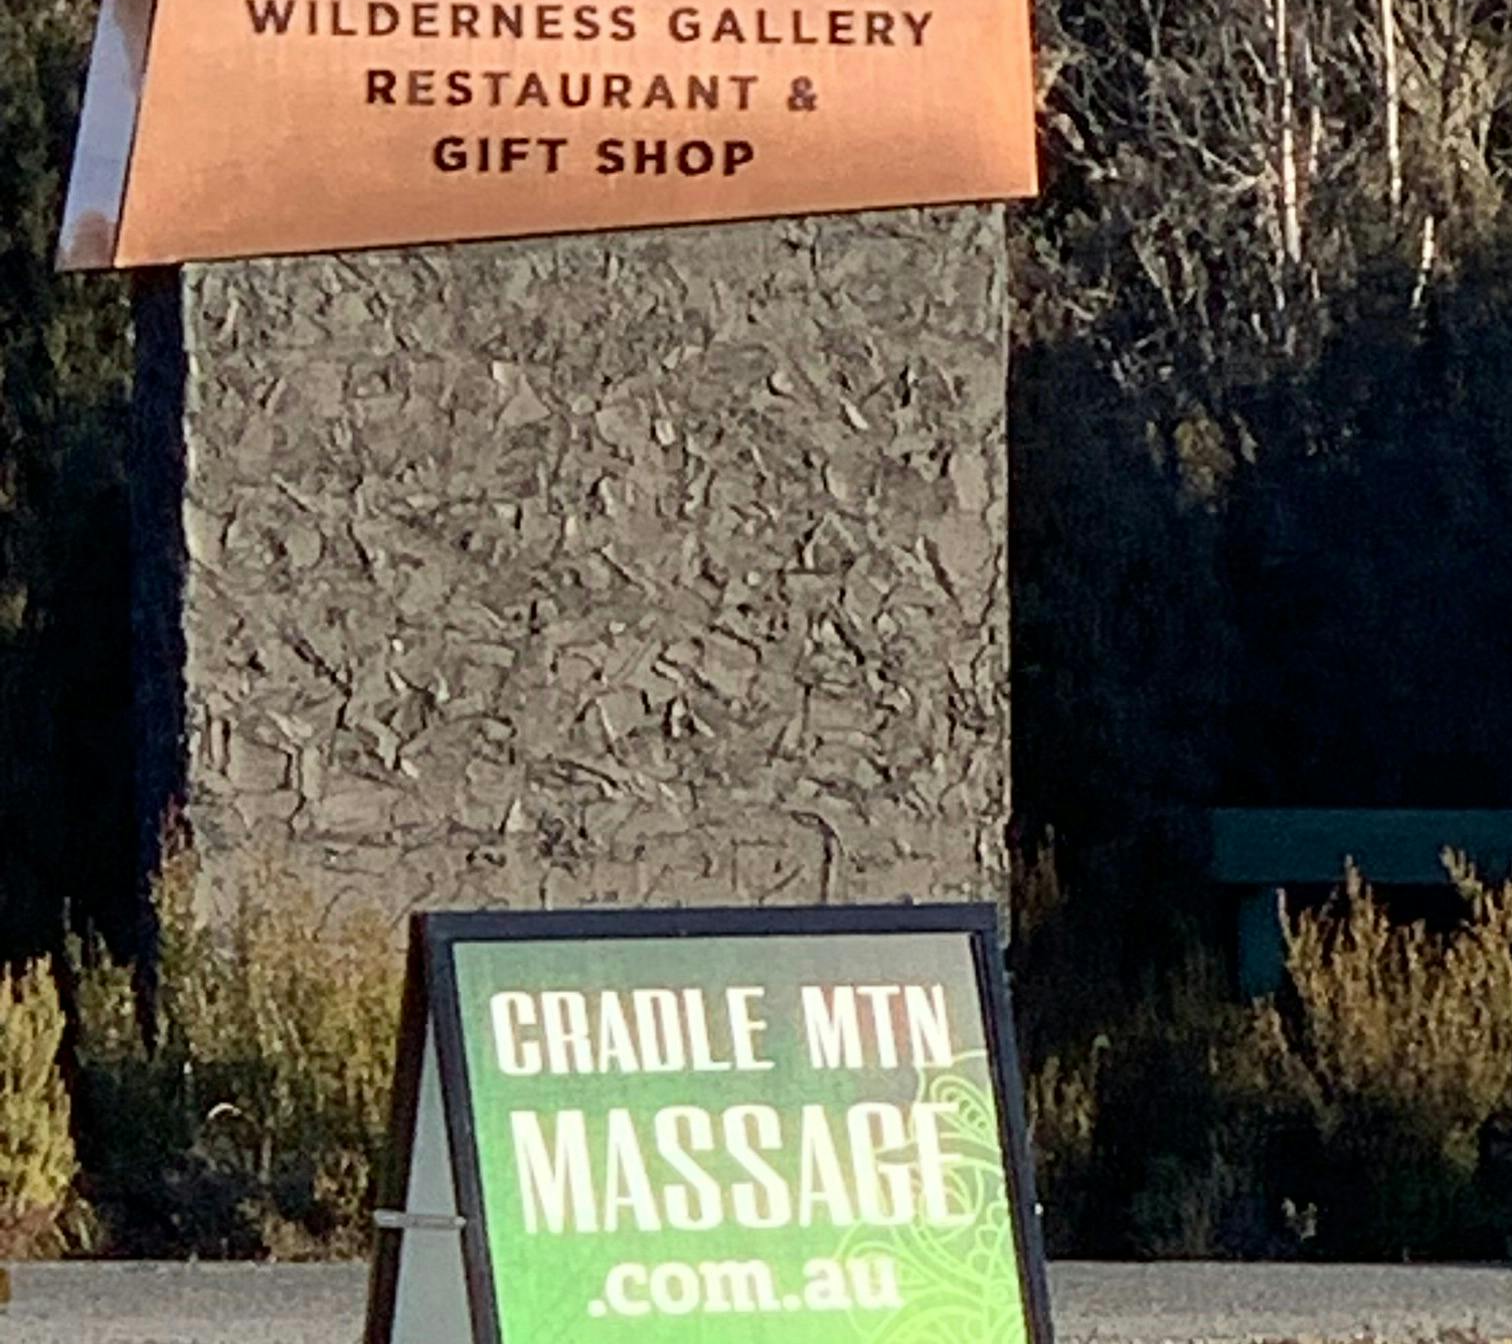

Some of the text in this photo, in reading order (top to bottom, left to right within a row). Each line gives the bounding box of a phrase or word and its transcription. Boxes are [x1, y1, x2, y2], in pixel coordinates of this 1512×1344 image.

[667, 6, 934, 47] GALLERY
[364, 68, 819, 113] RESTAURANT &
[431, 135, 757, 177] GIFT SHOP
[489, 983, 954, 1076] CRADLE MTN
[509, 1101, 977, 1236] MASSAGE
[587, 1255, 903, 1318] .com.au
